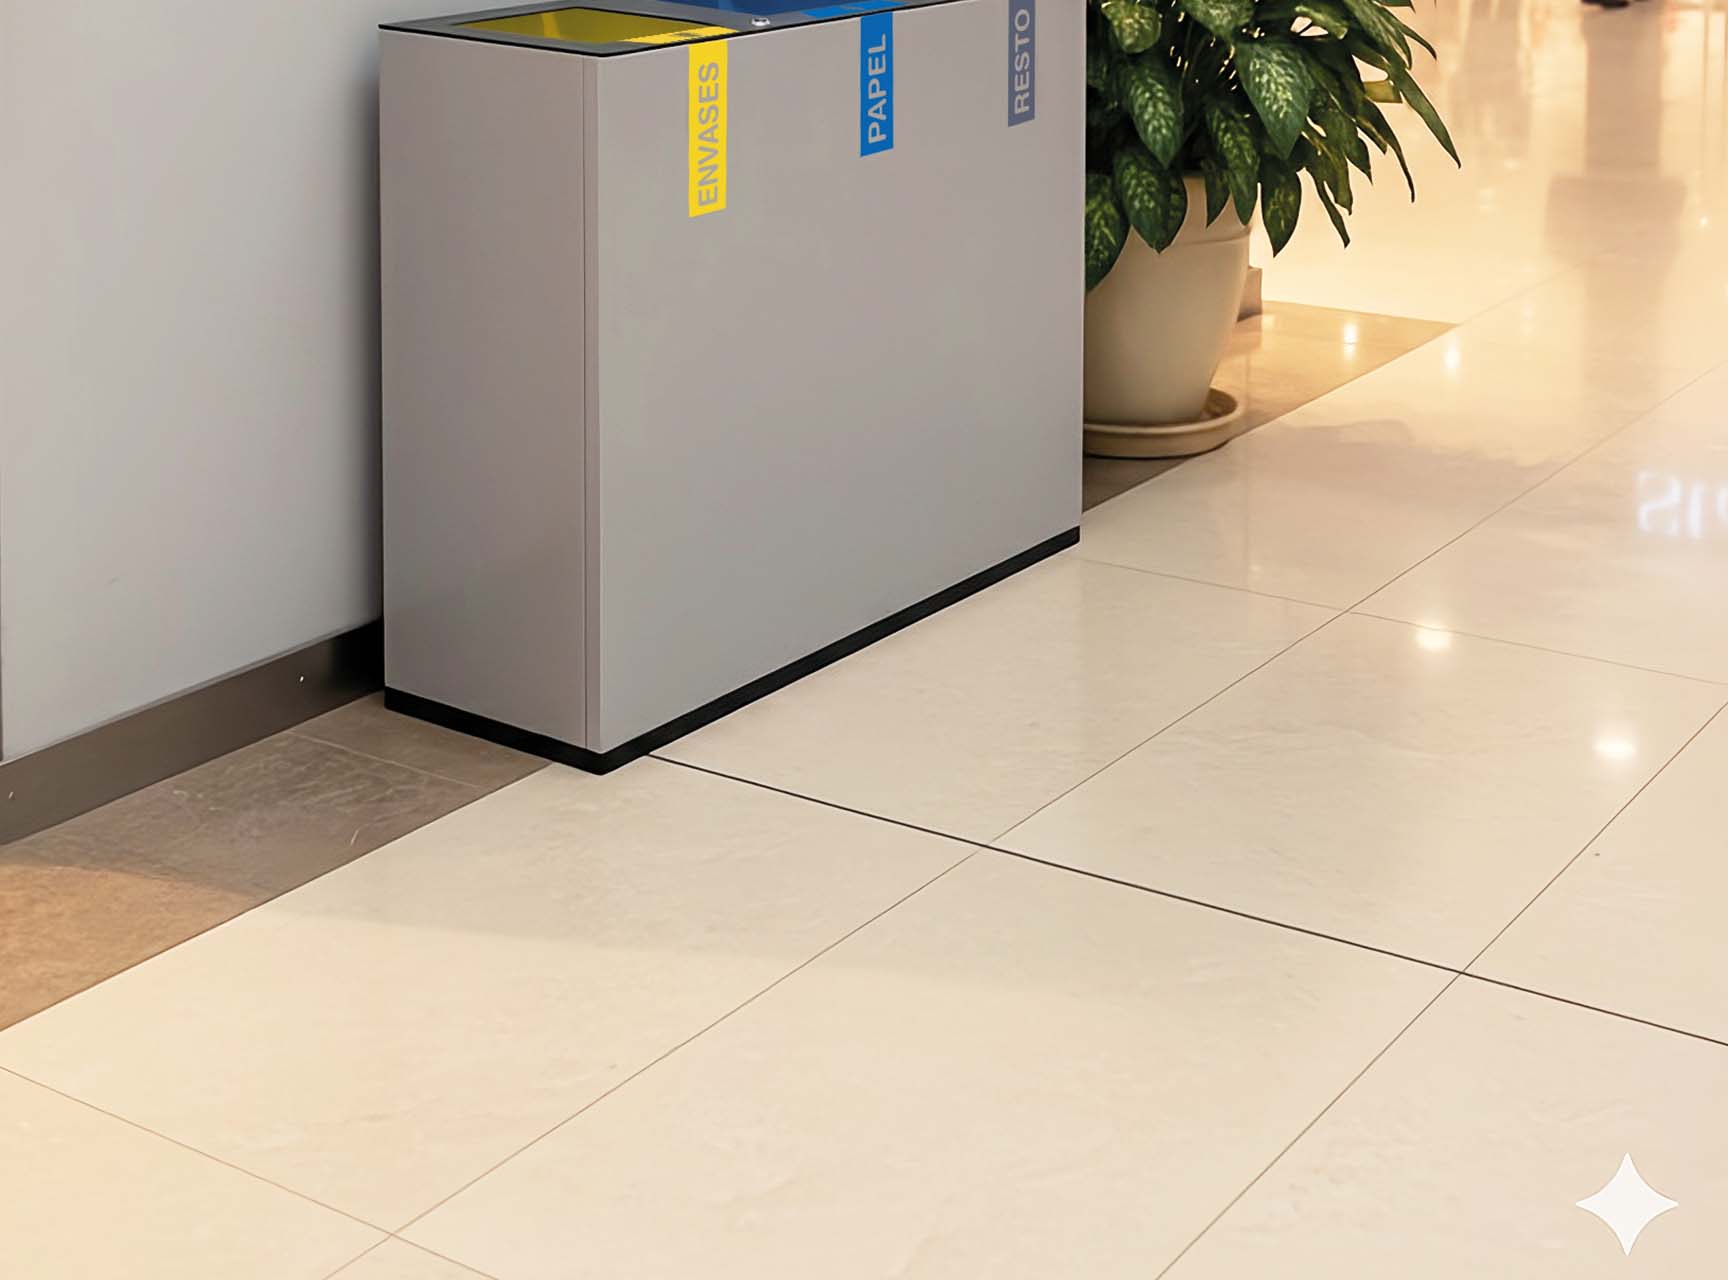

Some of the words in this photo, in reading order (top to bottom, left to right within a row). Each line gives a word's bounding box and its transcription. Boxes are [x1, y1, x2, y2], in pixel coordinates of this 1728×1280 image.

[867, 33, 887, 144] PAPEL
[1014, 8, 1030, 115] RESTO
[698, 62, 719, 206] ENVASES
